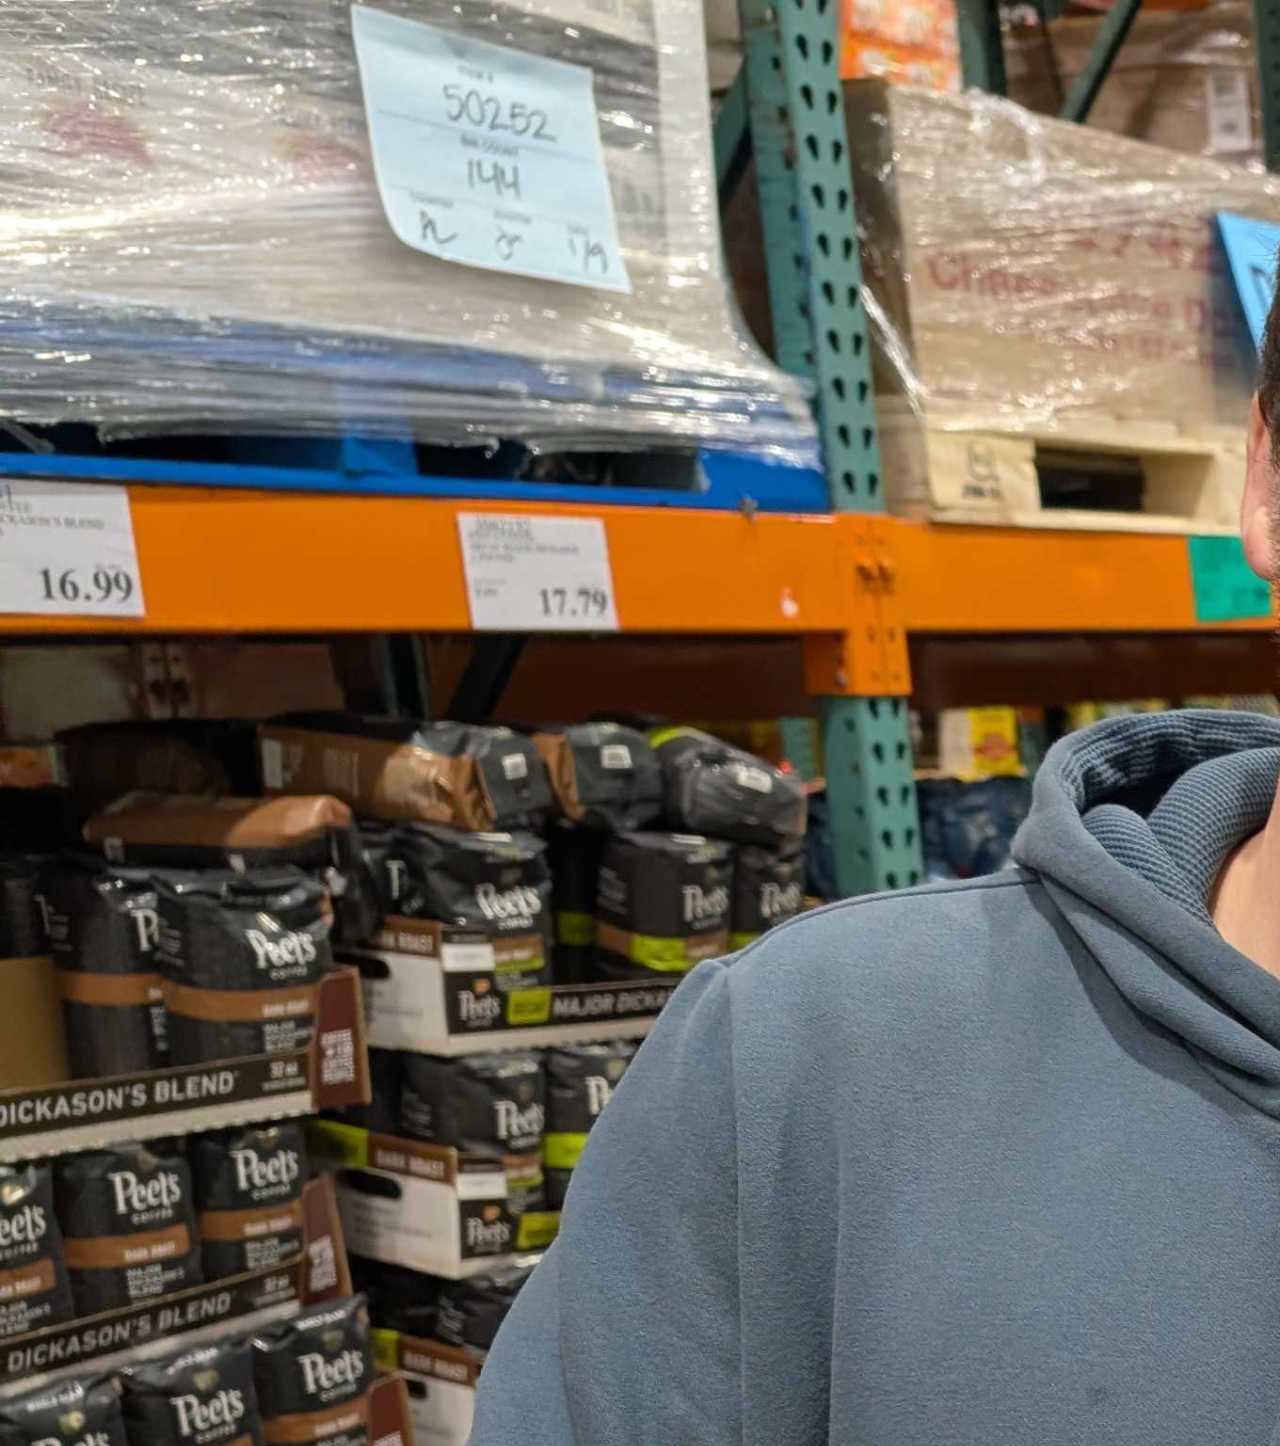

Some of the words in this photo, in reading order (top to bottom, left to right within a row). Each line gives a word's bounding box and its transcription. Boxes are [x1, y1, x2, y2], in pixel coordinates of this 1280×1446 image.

[443, 83, 558, 144] 50252
[467, 159, 522, 200] 144
[40, 567, 133, 604] 16.99
[539, 587, 608, 617] 17.79
[246, 929, 317, 969] Peet's
[155, 1070, 236, 1100] BLEND
[230, 1149, 299, 1192] Peet's
[108, 1171, 182, 1216] Peet's
[0, 1205, 47, 1247] eet's
[7, 1313, 151, 1373] DICKASON'S
[157, 1292, 233, 1331] BLEND
[297, 1351, 364, 1394] Peet's
[170, 1389, 245, 1438] Peet's
